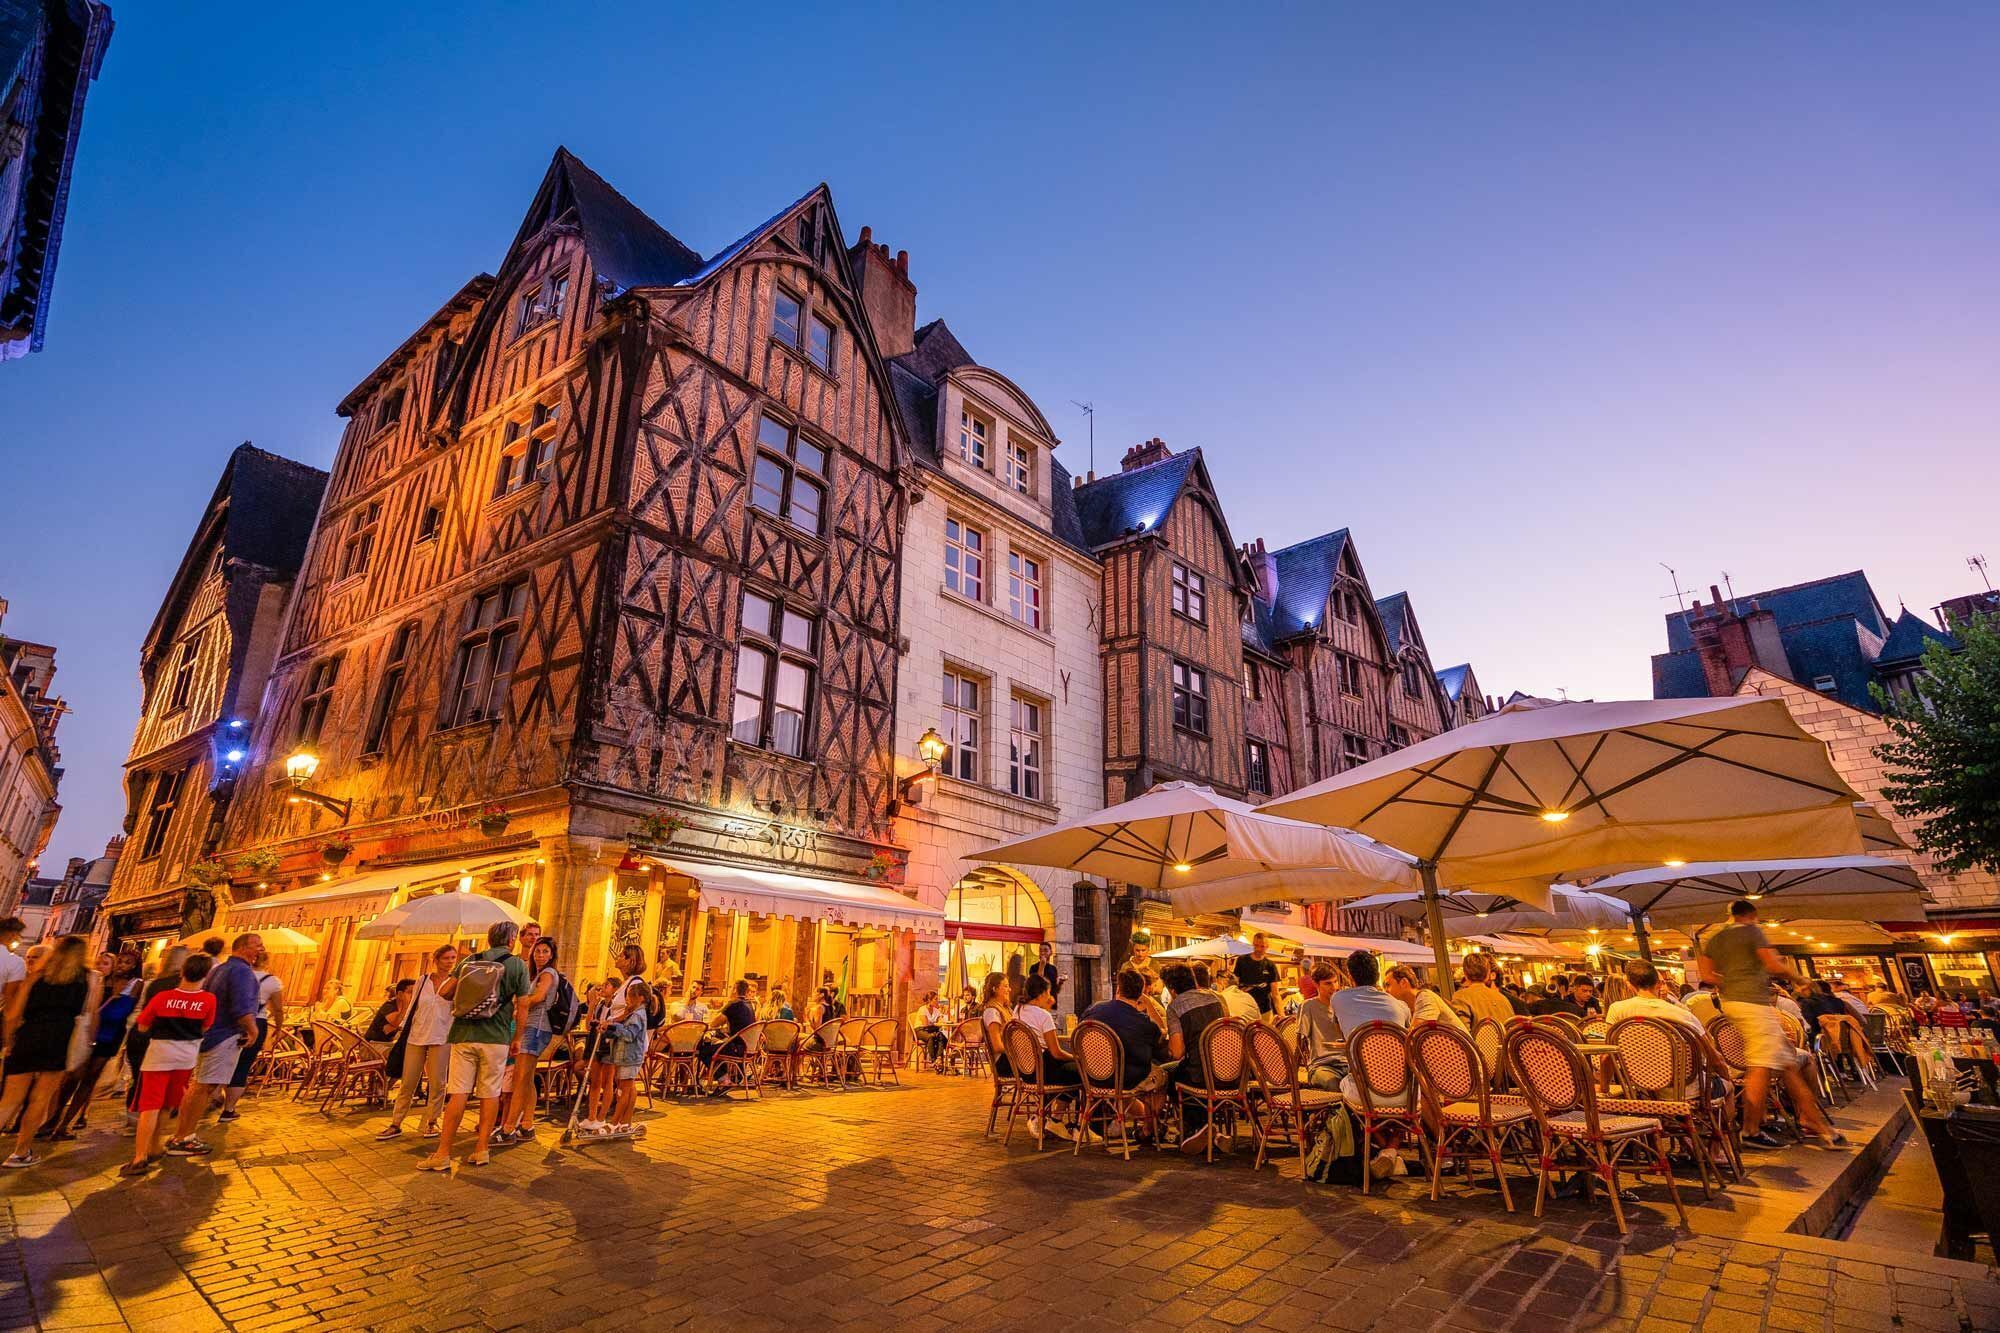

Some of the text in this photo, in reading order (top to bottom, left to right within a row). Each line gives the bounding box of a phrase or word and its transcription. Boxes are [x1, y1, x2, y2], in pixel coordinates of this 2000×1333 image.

[720, 896, 750, 908] BAR
[166, 999, 204, 1011] KICK ME
